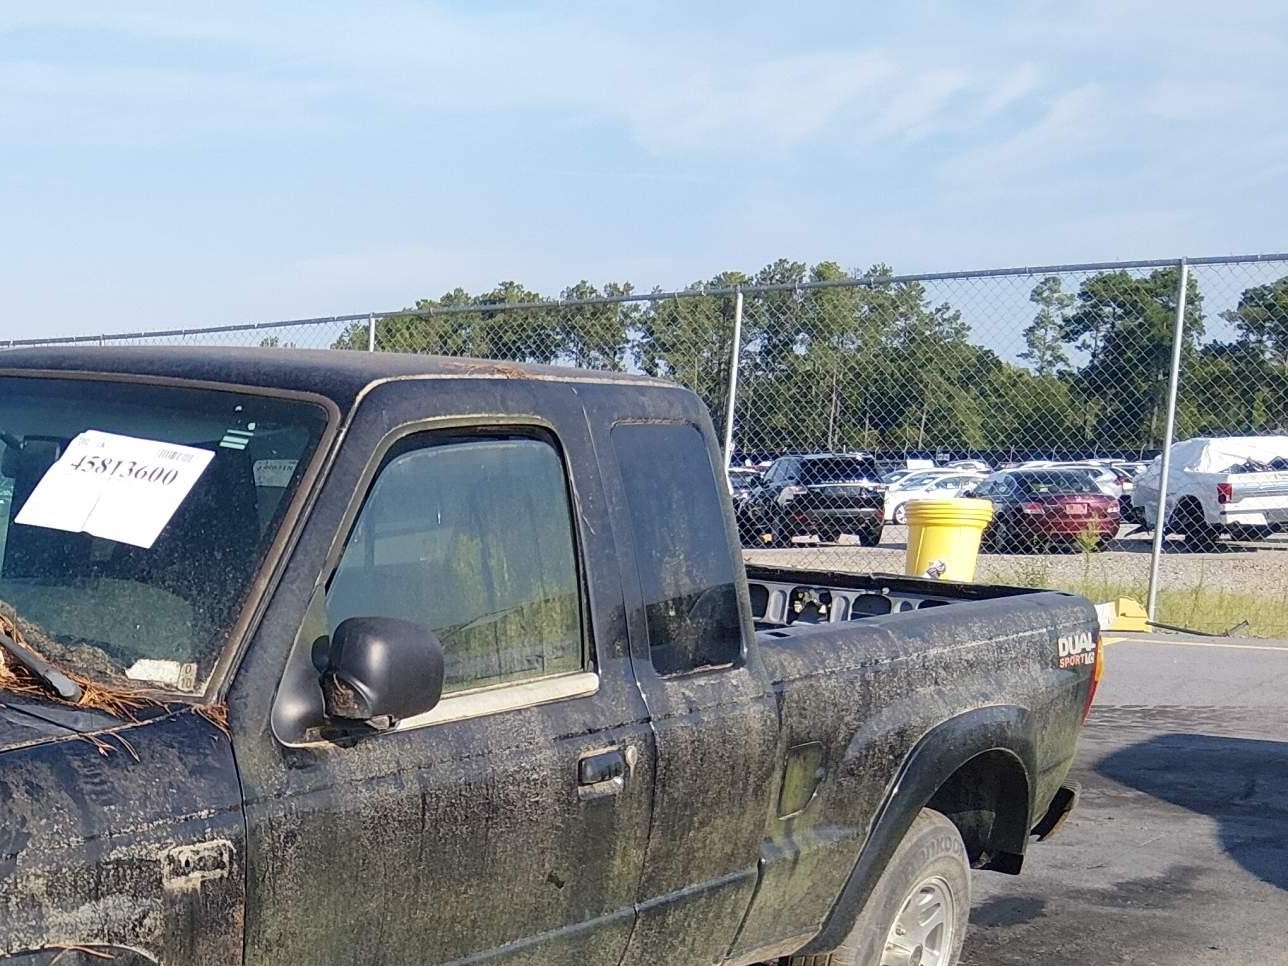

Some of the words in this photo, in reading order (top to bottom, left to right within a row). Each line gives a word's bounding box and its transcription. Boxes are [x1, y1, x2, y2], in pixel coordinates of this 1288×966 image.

[71, 455, 178, 485] 45813600
[1058, 632, 1096, 657] DUAL
[1059, 654, 1084, 668] SPORT
